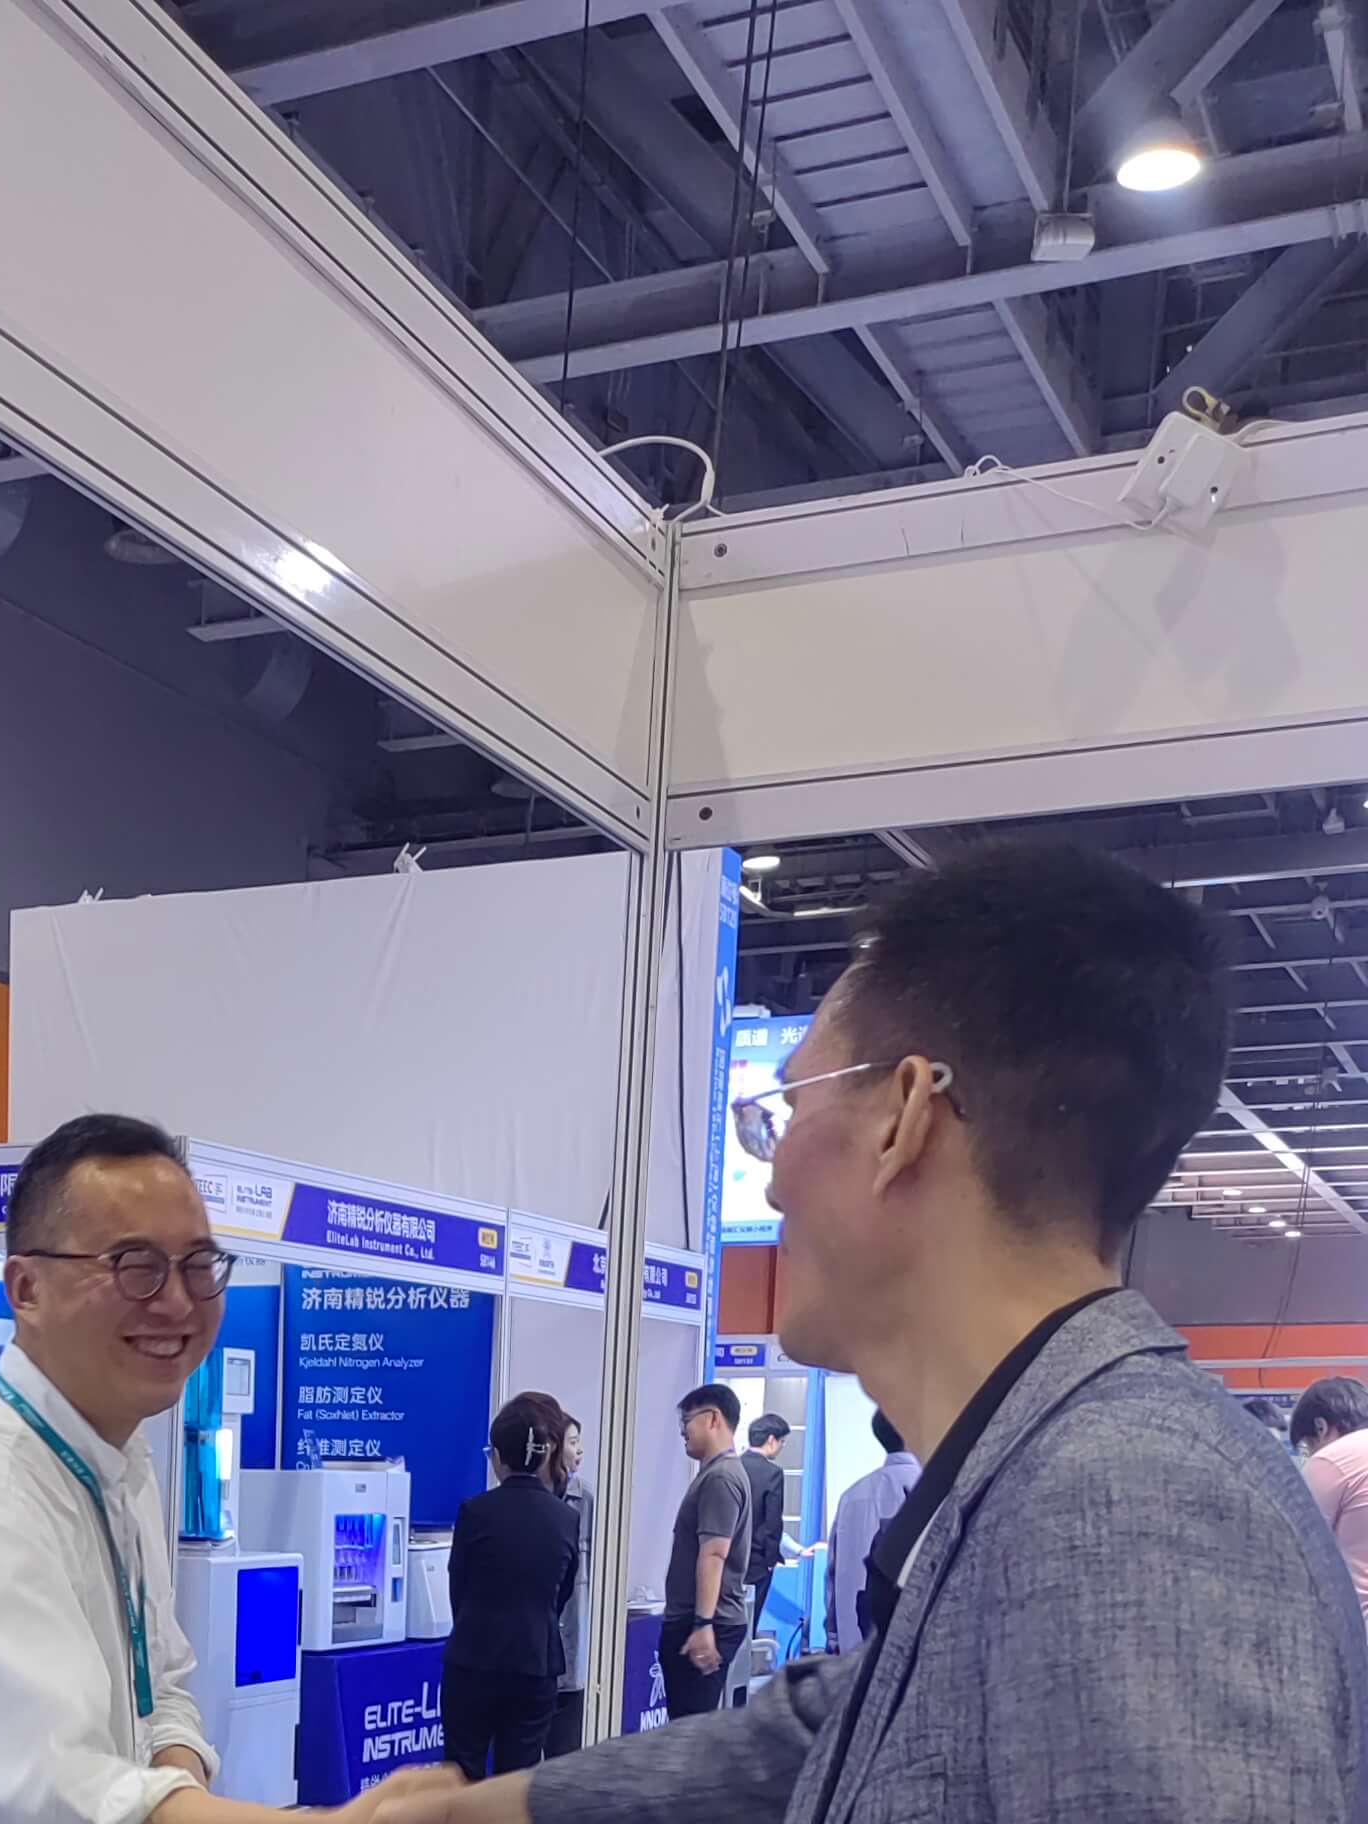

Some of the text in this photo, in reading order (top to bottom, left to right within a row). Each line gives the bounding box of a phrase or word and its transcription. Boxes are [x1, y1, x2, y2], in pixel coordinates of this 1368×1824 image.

[327, 1199, 436, 1244] 济南精锐分析仪器有限公司
[326, 1230, 359, 1249] EliteLab
[362, 1235, 403, 1256] Instrument
[301, 1286, 471, 1311] 济南精锐分析仪器
[300, 1332, 385, 1352] 凯氏定氮仪
[338, 1356, 381, 1371] Nitrogen
[382, 1356, 424, 1371] Analyzer
[298, 1385, 383, 1405] 脂肪测定仪
[361, 1408, 405, 1421] Extractor
[364, 1681, 441, 1731] ELITE-L
